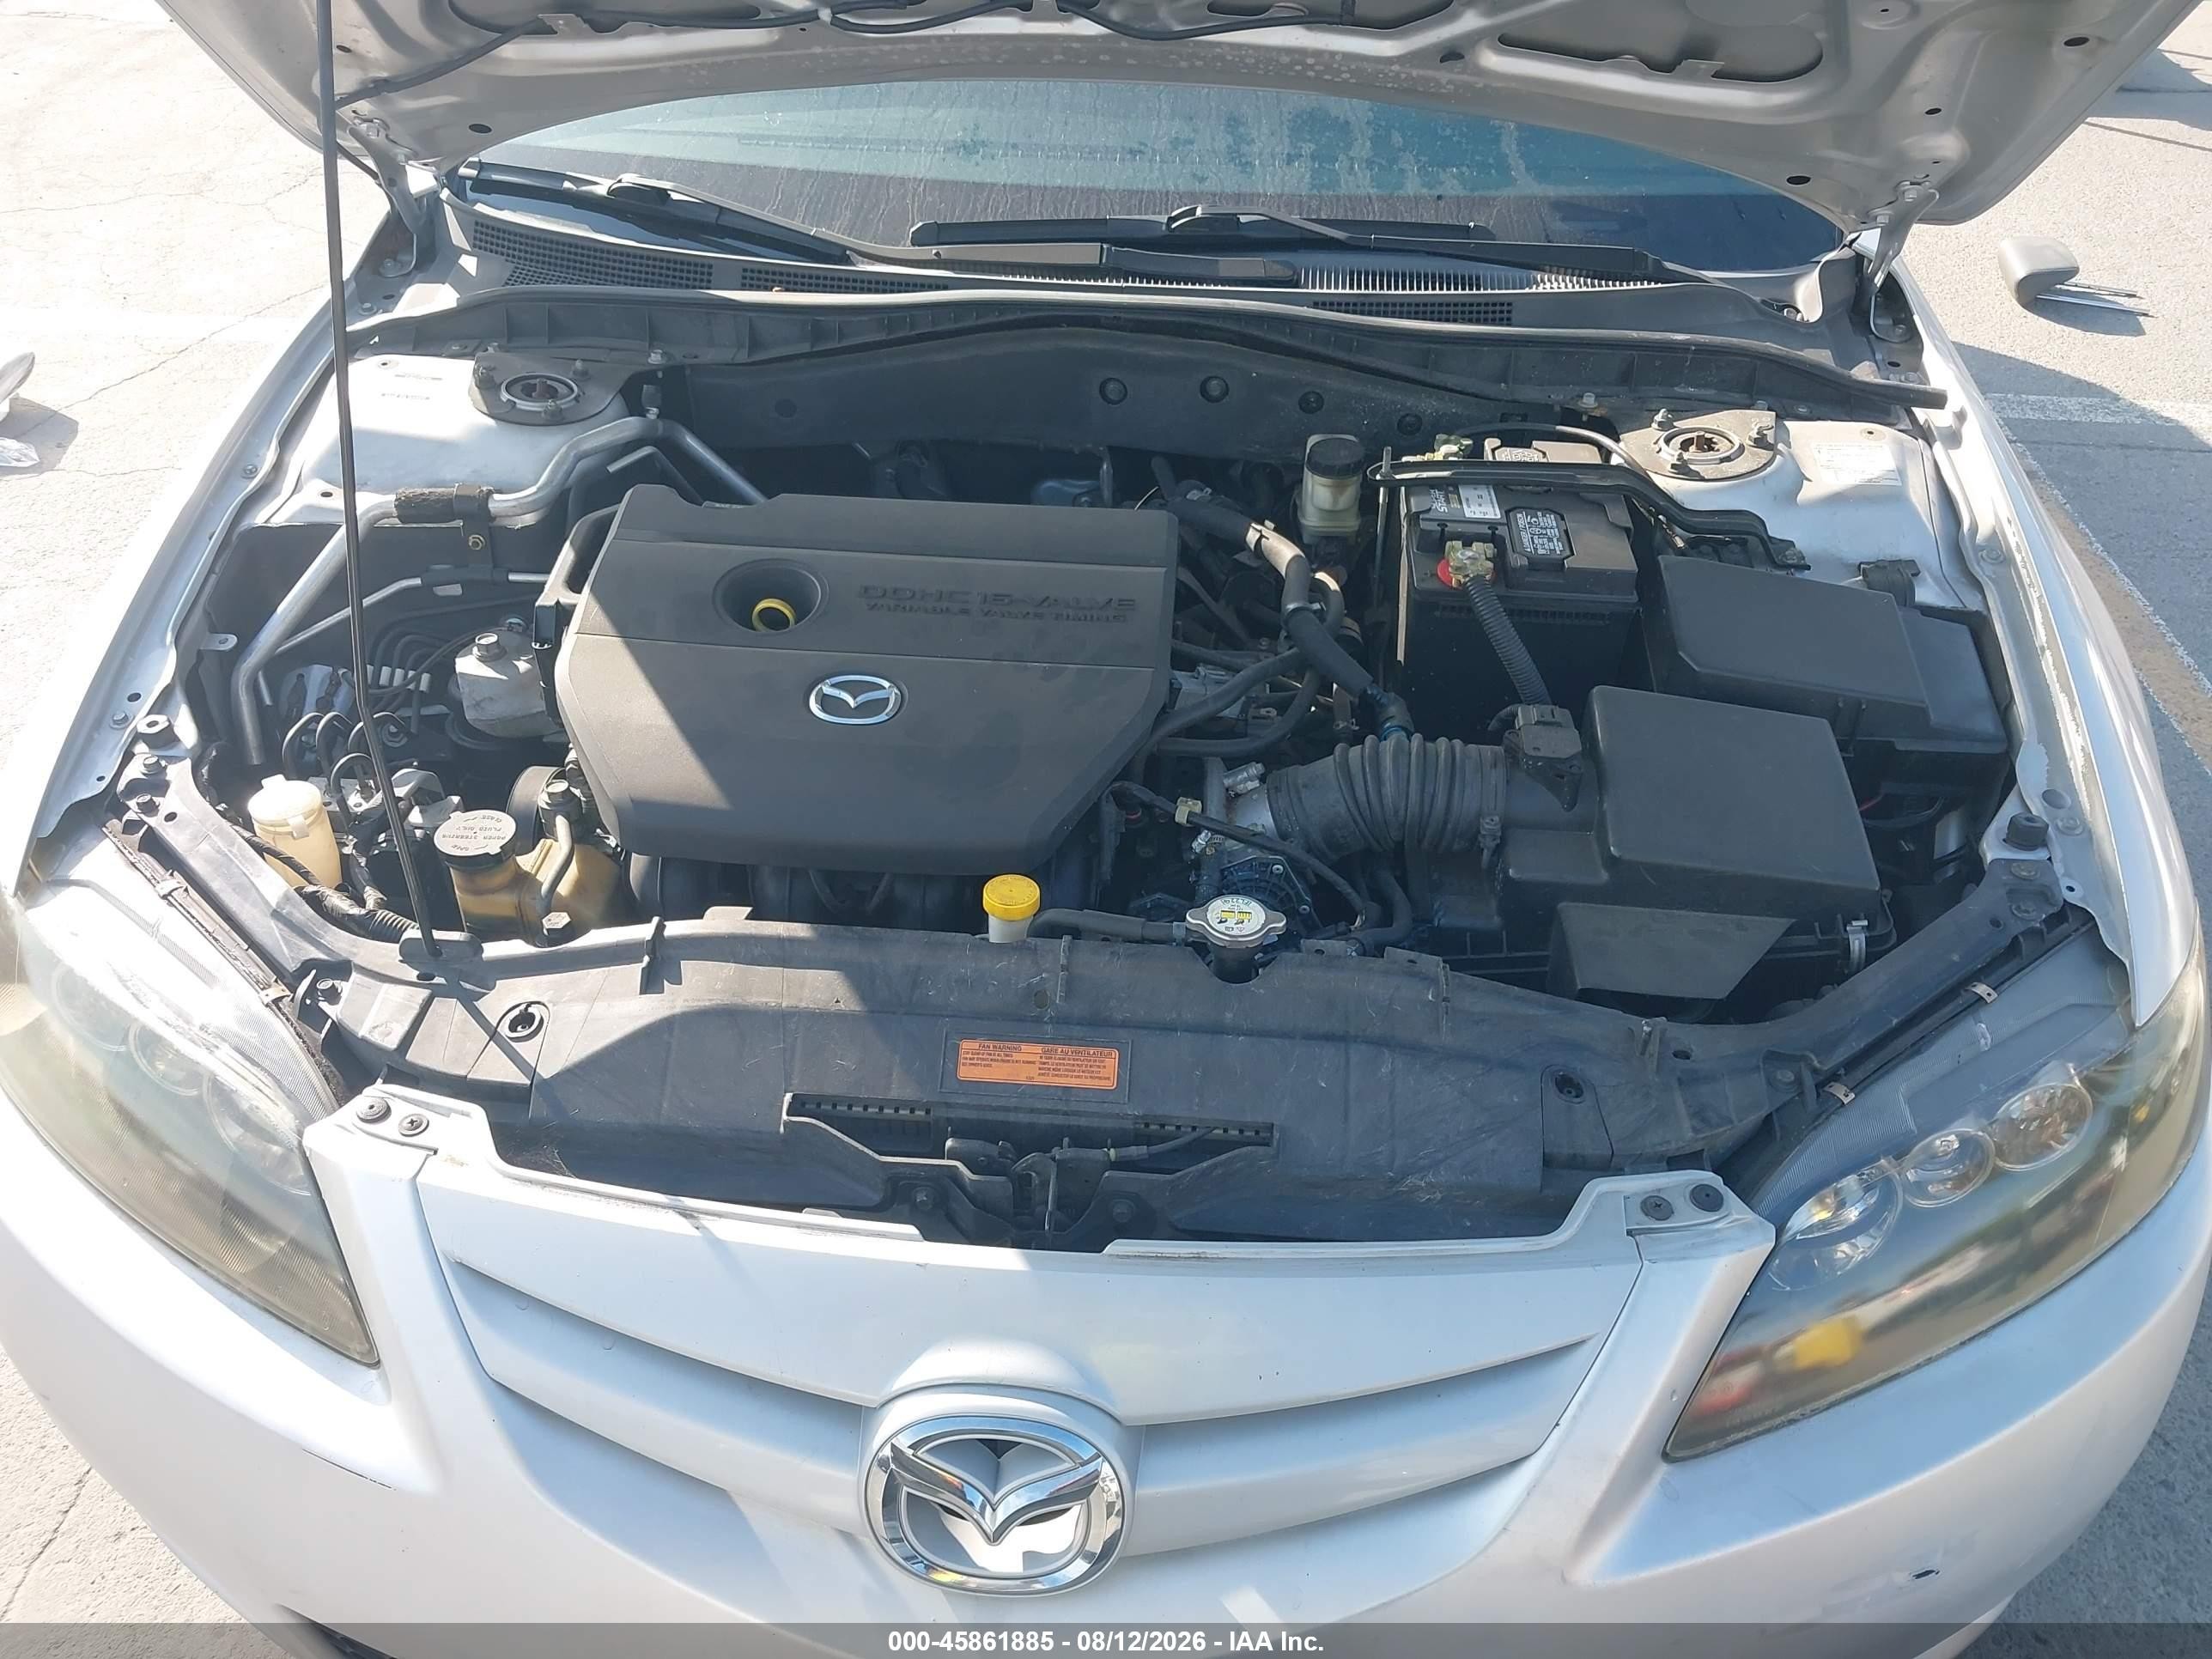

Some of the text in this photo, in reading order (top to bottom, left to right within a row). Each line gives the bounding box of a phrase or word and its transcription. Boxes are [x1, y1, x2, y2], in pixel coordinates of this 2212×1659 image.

[860, 585, 971, 604] DOHC
[866, 602, 1127, 623] VARIABLE VALVE TIMING
[1070, 1048, 1113, 1057] VENTILATEUR
